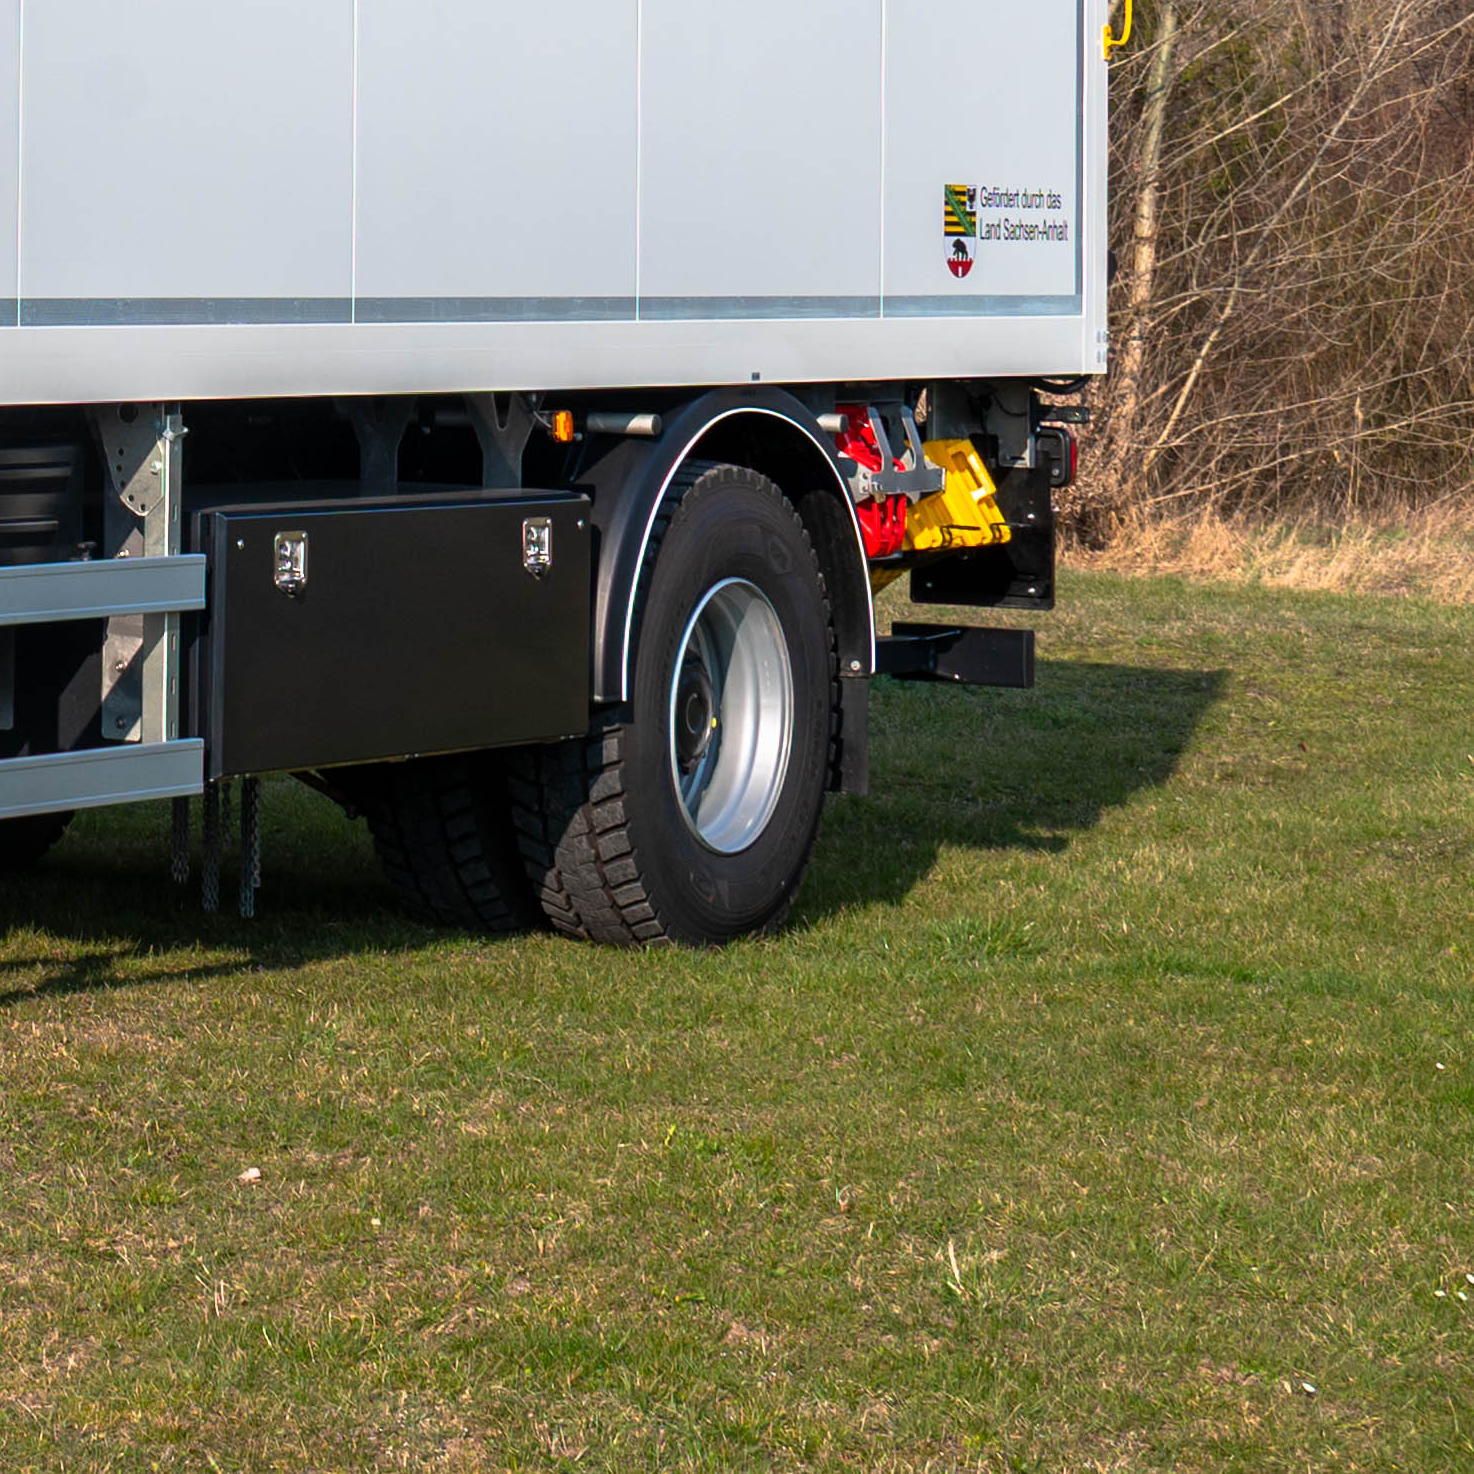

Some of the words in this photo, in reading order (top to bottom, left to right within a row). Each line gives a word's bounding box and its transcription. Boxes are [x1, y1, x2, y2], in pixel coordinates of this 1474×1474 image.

[1021, 188, 1044, 209] durch
[1046, 189, 1062, 209] das
[979, 217, 1001, 240] Land
[1003, 218, 1068, 241] Sachsen-Anhalt
